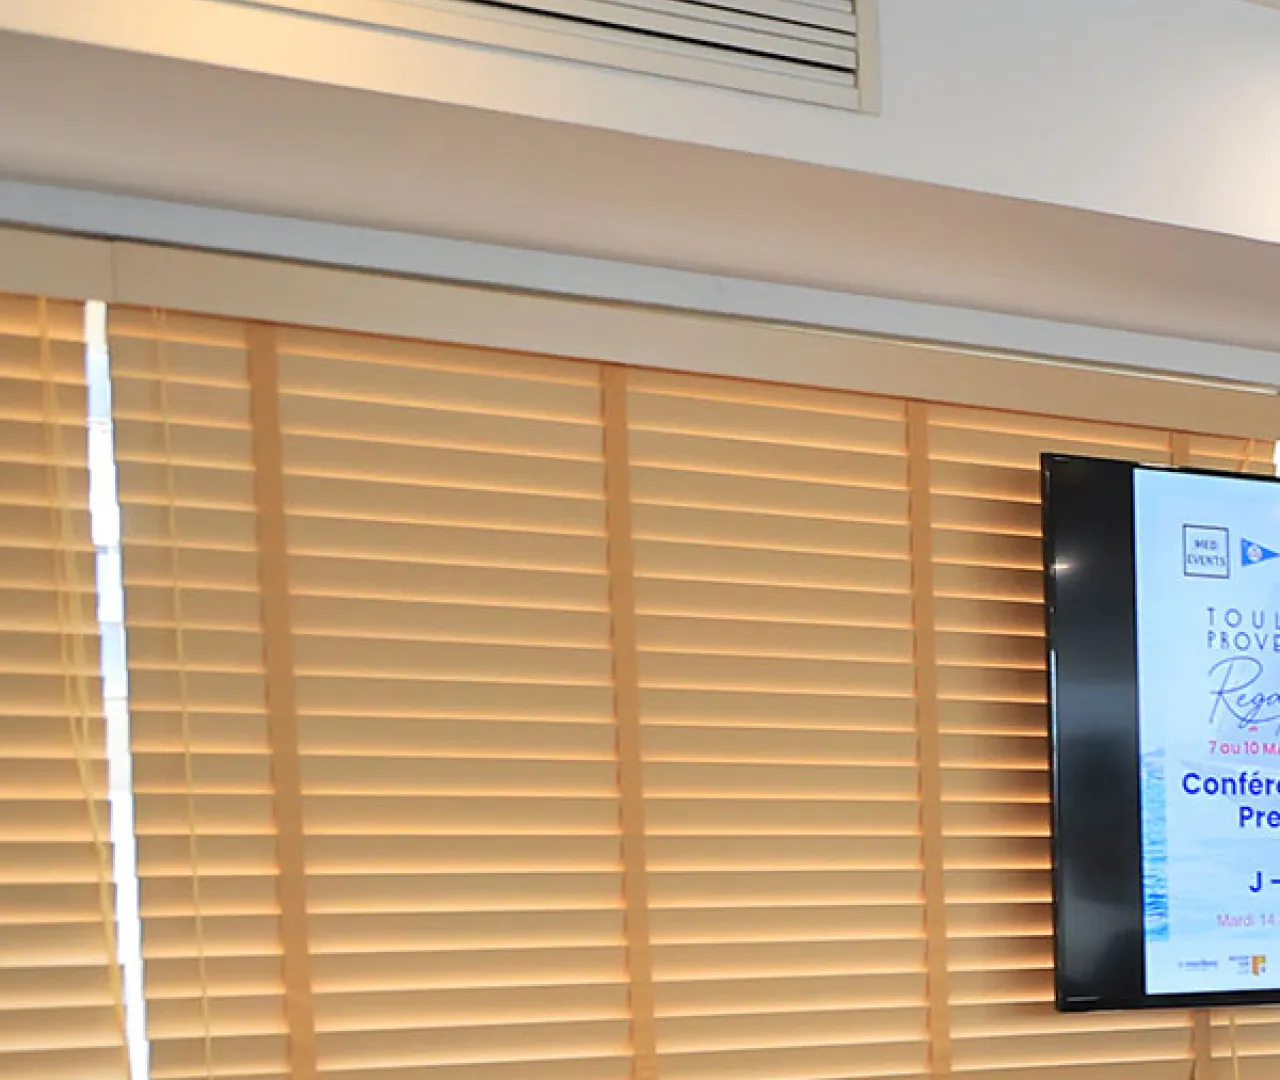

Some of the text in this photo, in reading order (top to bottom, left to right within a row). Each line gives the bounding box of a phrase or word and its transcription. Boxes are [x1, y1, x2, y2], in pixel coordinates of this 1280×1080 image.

[1208, 740, 1217, 754] 7
[1220, 742, 1241, 755] au
[1244, 741, 1260, 755] 10
[1249, 870, 1263, 893] J
[1216, 913, 1255, 927] Mardi
[1260, 913, 1275, 927] 14
